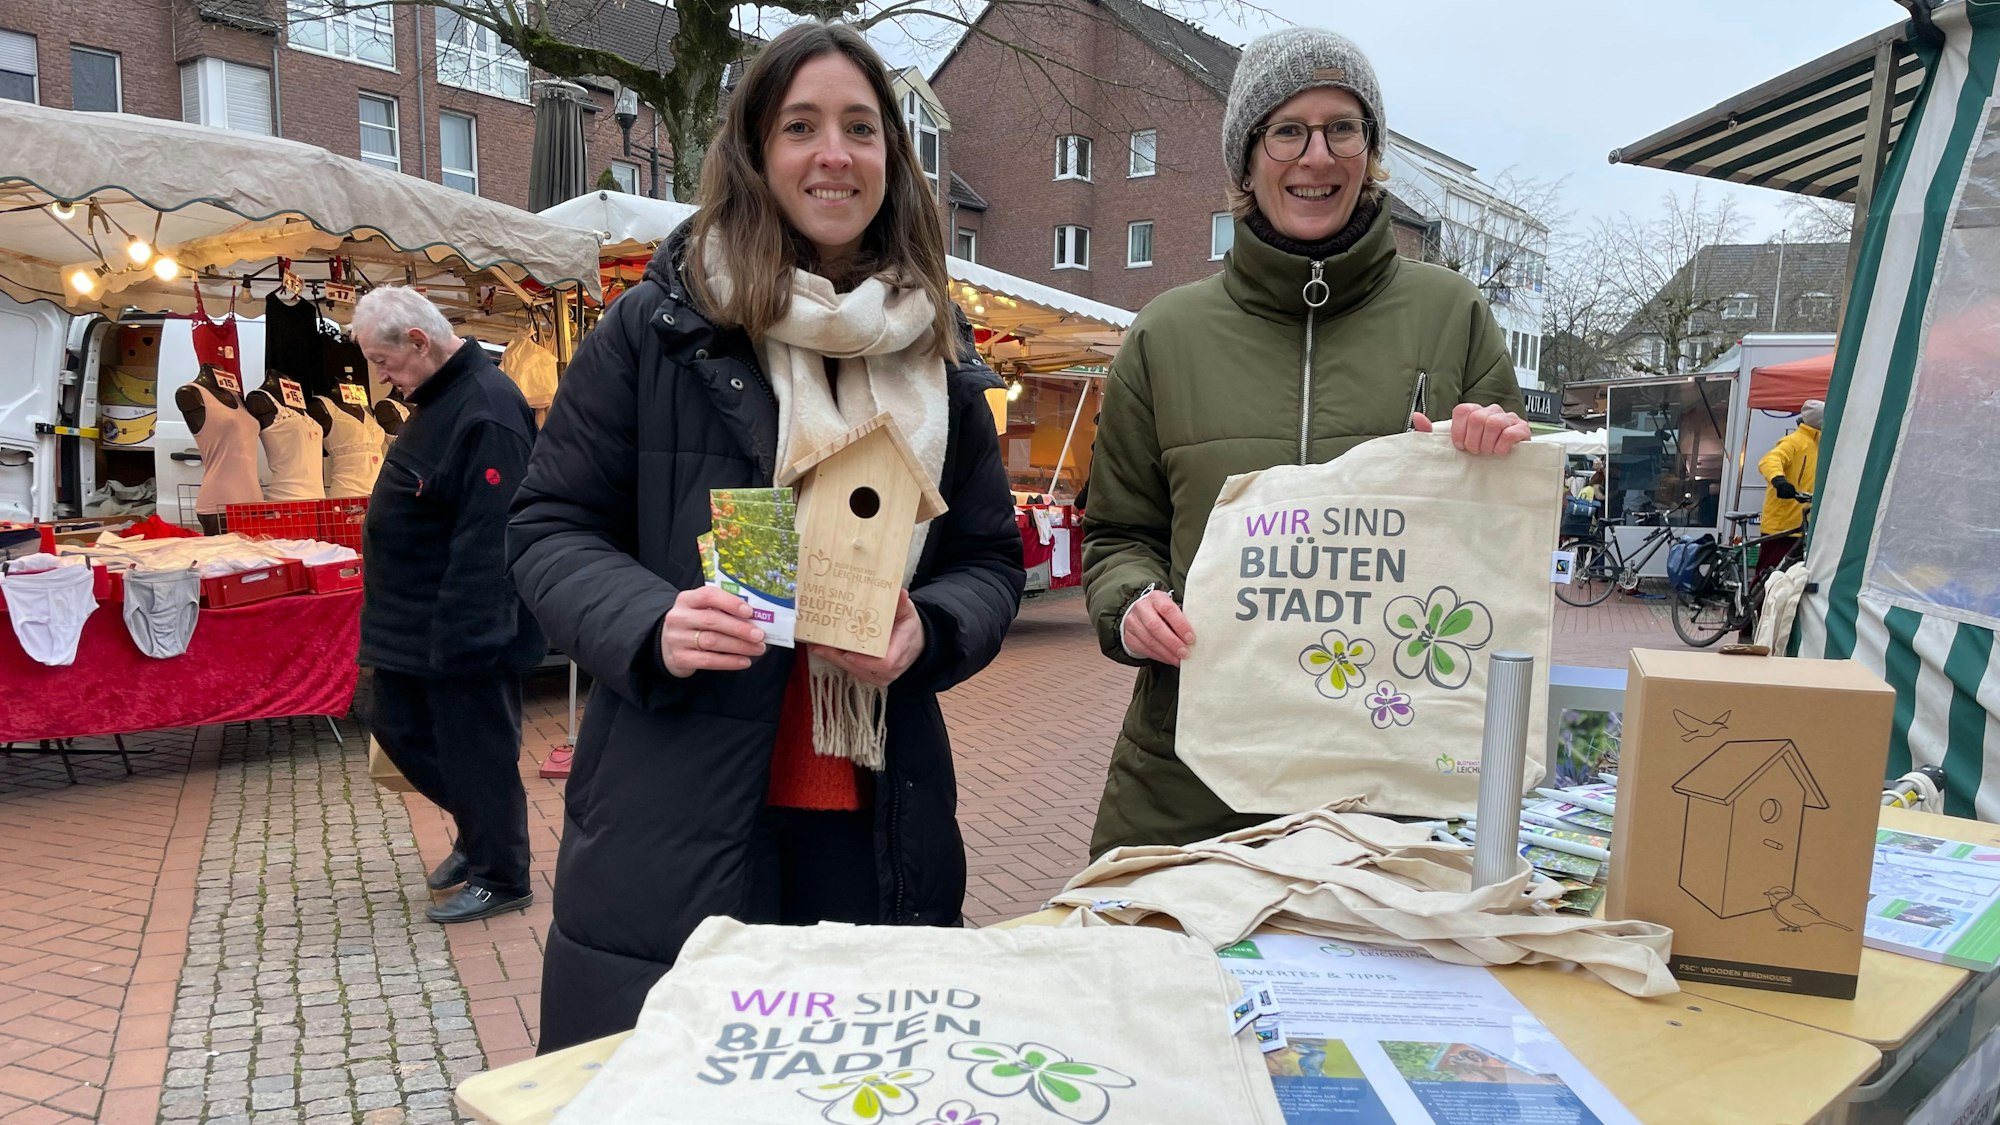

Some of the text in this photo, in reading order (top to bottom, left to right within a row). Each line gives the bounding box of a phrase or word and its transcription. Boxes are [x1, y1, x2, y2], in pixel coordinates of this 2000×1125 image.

[1525, 395, 1550, 414] JULIA
[1246, 507, 1406, 537] WIR SIND
[1240, 536, 1406, 583] BLÜTEN
[833, 568, 893, 590] LEICHLINGEN
[803, 581, 855, 602] WIR SIND
[754, 611, 772, 621] TADT
[800, 595, 853, 617] BLÜTEN
[1235, 586, 1371, 625] STADT
[797, 608, 840, 628] STADT
[1456, 766, 1481, 774] LEICHL
[1230, 968, 1320, 978] SWERTES
[1345, 972, 1397, 981] TIPPS
[1701, 966, 1741, 977] WOODEN
[1743, 971, 1793, 983] BIRDHOUSE
[731, 988, 981, 1017] WIR SIND
[715, 1011, 980, 1052] BLÜTEN
[697, 1039, 928, 1085] STADT
